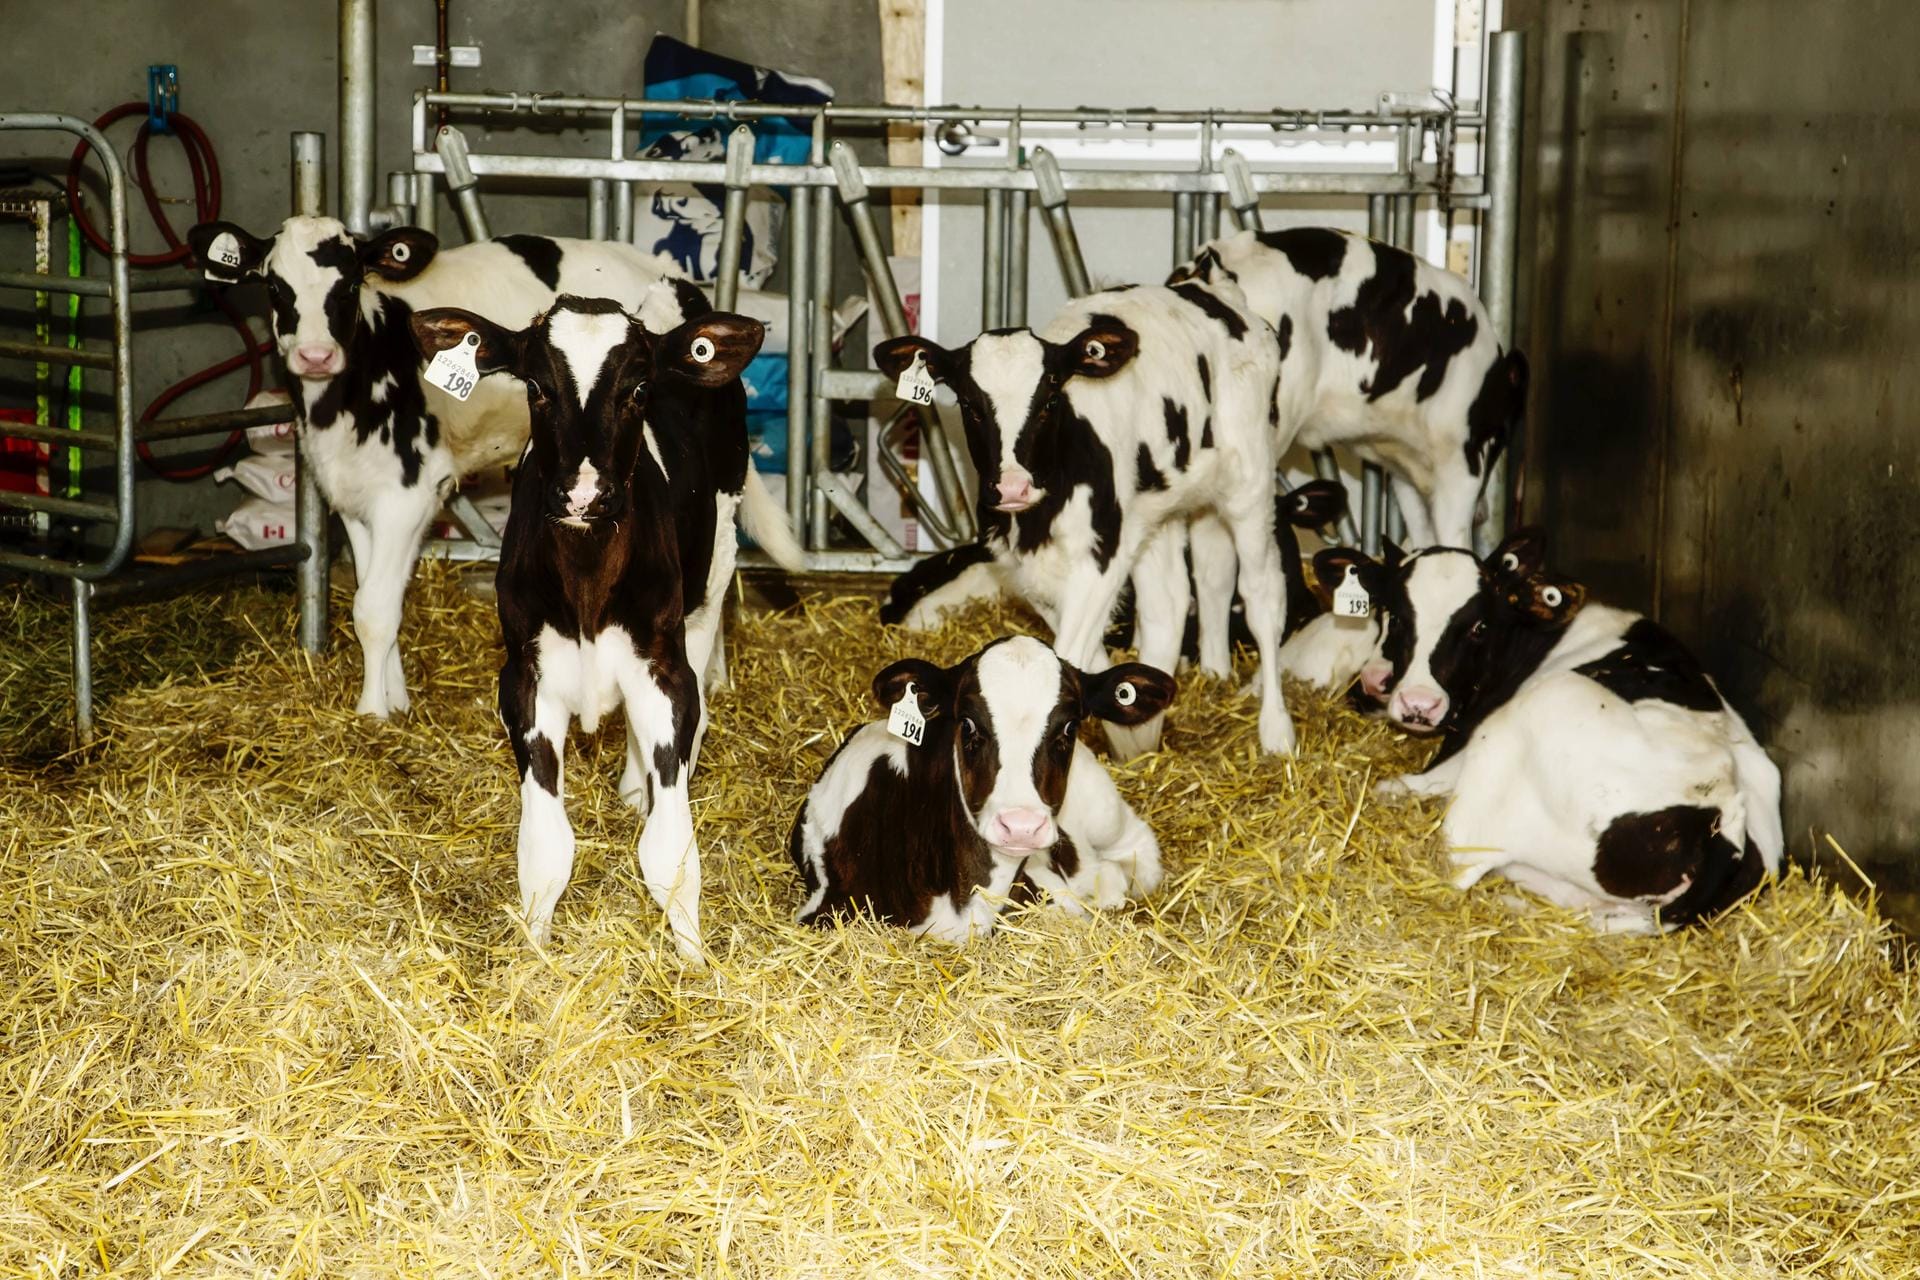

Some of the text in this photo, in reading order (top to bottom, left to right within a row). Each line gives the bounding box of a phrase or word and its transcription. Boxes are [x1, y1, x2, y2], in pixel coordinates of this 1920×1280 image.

[221, 252, 239, 265] 201
[443, 372, 473, 398] 198
[912, 385, 932, 403] 196
[1350, 600, 1369, 615] 193
[902, 720, 922, 743] 194
